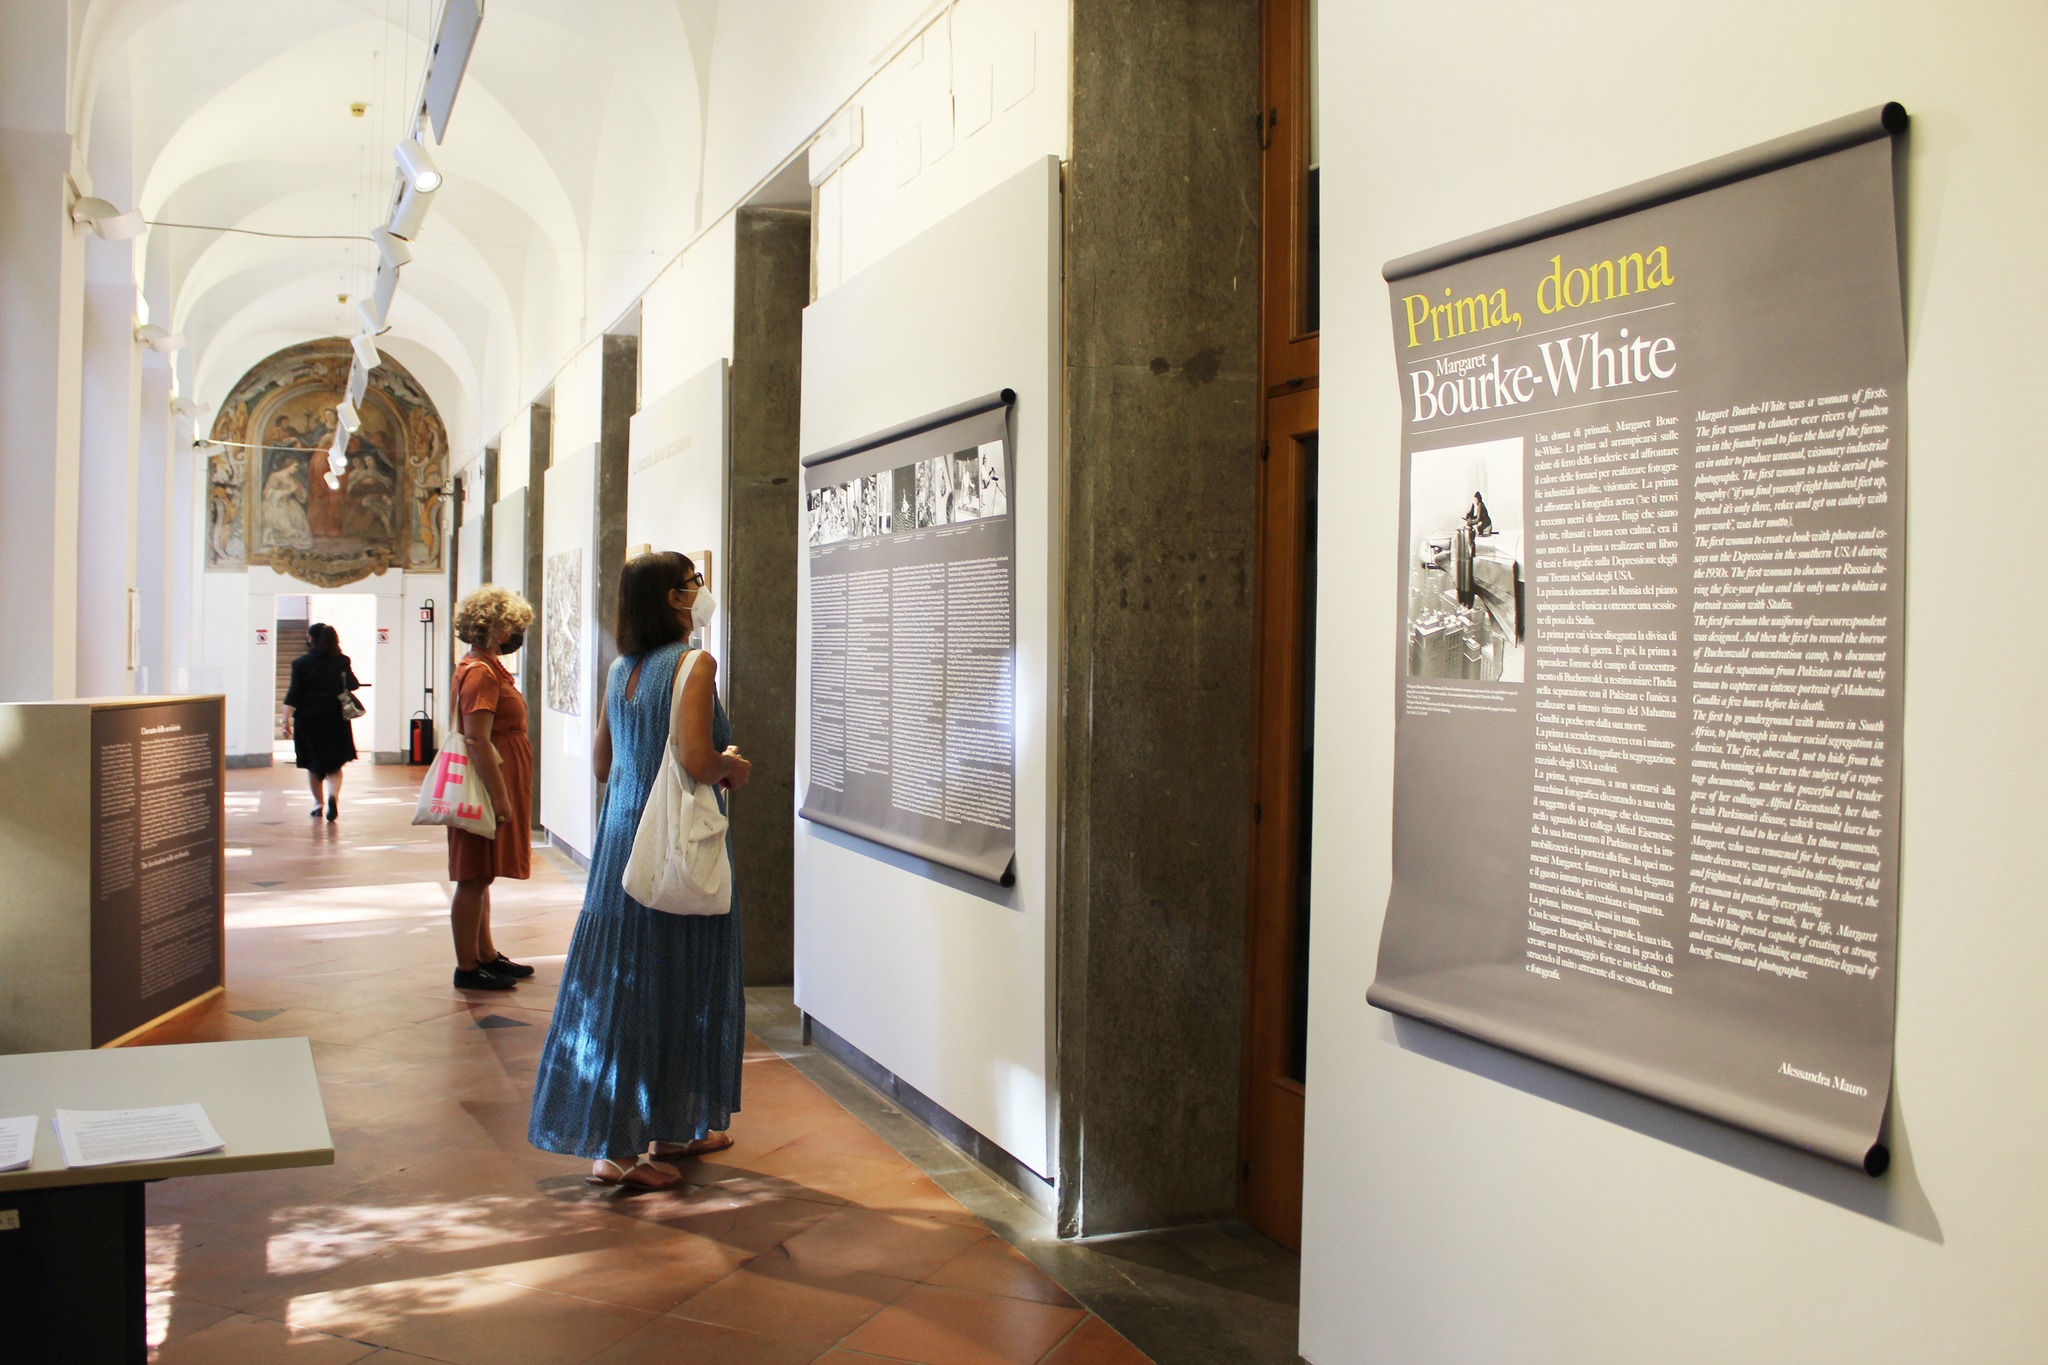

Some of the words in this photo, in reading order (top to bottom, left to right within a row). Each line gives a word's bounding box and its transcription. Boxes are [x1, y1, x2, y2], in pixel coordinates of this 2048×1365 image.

[1402, 287, 1522, 348] Prima,
[1537, 246, 1675, 315] donna
[1409, 328, 1677, 422] Bourke-White
[1436, 353, 1487, 377] Margaret
[1694, 408, 1729, 422] Margaret
[1731, 400, 1786, 417] Bourke-White
[1788, 399, 1805, 409] was
[1807, 398, 1814, 407] a
[1817, 393, 1848, 405] woman
[1851, 388, 1863, 404] of
[1535, 433, 1548, 442] Una
[1550, 431, 1570, 440] donna
[1573, 427, 1580, 437] di
[1584, 423, 1611, 438] primati,
[1615, 419, 1651, 432] Margaret
[1655, 415, 1679, 426] Bour-
[1696, 426, 1710, 437] The
[1709, 424, 1726, 438] first
[1728, 422, 1756, 433] woman
[1757, 420, 1766, 429] to
[1767, 415, 1799, 428] clamber
[1800, 414, 1820, 424] over
[1820, 410, 1845, 422] rivers
[1847, 406, 1859, 422] of
[1858, 404, 1888, 417] molten
[1534, 445, 1563, 456] ke-White.
[1565, 443, 1575, 452] La
[1576, 441, 1596, 453] prima
[1598, 437, 1607, 448] ad
[1659, 429, 1679, 441] sulle
[1742, 469, 1757, 480] The
[1756, 467, 1775, 482] first
[1775, 467, 1805, 477] woman
[1806, 465, 1815, 474] to
[1816, 460, 1840, 473] tackle
[1841, 457, 1868, 471] aerial
[1867, 456, 1888, 472] pho-
[1576, 483, 1601, 494] insolite,
[1602, 480, 1639, 491] visionarie.
[1641, 478, 1653, 488] La
[1654, 476, 1678, 490] prima
[1540, 517, 1565, 526] trecento
[1567, 513, 1584, 524] metri
[1585, 513, 1593, 523] di
[1594, 512, 1620, 522] altezza,
[1621, 509, 1639, 522] fingi
[1640, 508, 1655, 518] che
[1656, 507, 1678, 518] siano
[1693, 503, 1722, 518] pretend
[1733, 501, 1750, 515] only
[1751, 500, 1772, 512] three,
[1773, 498, 1794, 510] relax
[1794, 496, 1812, 509] and
[1811, 497, 1825, 510] get
[1825, 498, 1836, 506] on
[1837, 492, 1866, 508] calmly
[1867, 491, 1887, 504] with
[1535, 531, 1548, 540] solo
[1561, 528, 1585, 539] rilassati
[1592, 527, 1613, 537] lavora
[1657, 525, 1670, 533] era
[1672, 522, 1677, 532] il
[1572, 543, 1581, 552] La
[1583, 542, 1603, 554] prima
[1604, 543, 1609, 551] a
[1610, 540, 1644, 551] realizzare
[1645, 541, 1656, 549] un
[1658, 538, 1677, 548] libro
[1693, 584, 1709, 597] ring
[1709, 583, 1722, 593] the
[1720, 582, 1755, 596] five-year
[1754, 582, 1774, 596] plan
[1774, 581, 1792, 593] and
[1792, 581, 1805, 592] the
[1806, 580, 1824, 595] only
[1824, 583, 1840, 592] one
[1841, 582, 1850, 591] to
[1851, 579, 1878, 591] obtain
[1879, 582, 1886, 590] a
[1537, 658, 1568, 668] riprendere
[1591, 659, 1602, 669] del
[1603, 662, 1627, 672] campo
[1628, 660, 1636, 670] di
[1638, 663, 1677, 671] concentra-
[1692, 646, 1703, 659] of
[1703, 646, 1749, 658] Buchenwald
[1751, 648, 1802, 659] concentration
[1804, 651, 1829, 663] camp,
[1832, 650, 1842, 660] to
[1844, 649, 1886, 661] document
[1535, 699, 1565, 709] realizzare
[1577, 701, 1600, 712] intenso
[1601, 703, 1625, 714] ritratto
[1626, 705, 1638, 715] del
[1640, 705, 1676, 718] Mahatma
[1693, 709, 1707, 720] The
[1705, 710, 1723, 723] first
[1724, 712, 1732, 722] to
[1732, 715, 1742, 725] go
[1744, 713, 1793, 727] underground
[1794, 716, 1814, 727] with
[1815, 717, 1845, 729] miners
[1846, 718, 1856, 730] in
[1857, 719, 1884, 731] South
[1534, 767, 1544, 778] La
[1545, 770, 1567, 781] prima,
[1614, 781, 1627, 789] non
[1629, 783, 1659, 793] sottrarsi
[1661, 784, 1675, 795] alla
[1707, 773, 1755, 791] documenting,
[1758, 779, 1782, 791] under
[1782, 781, 1796, 793] the
[1796, 784, 1835, 798] powerful
[1835, 787, 1854, 799] and
[1855, 789, 1883, 801] tender
[1689, 790, 1707, 801] gaze
[1708, 790, 1718, 803] of
[1717, 790, 1731, 802] her
[1731, 792, 1765, 808] colleague
[1765, 796, 1792, 810] Alfred
[1844, 804, 1860, 816] her
[1689, 896, 1709, 910] With
[1711, 901, 1725, 912] her
[1726, 904, 1753, 920] images,
[1756, 909, 1770, 921] her
[1772, 915, 1797, 928] words,
[1800, 917, 1815, 930] her
[1816, 920, 1832, 935] life,
[1836, 924, 1877, 942] Margaret
[1778, 1062, 1830, 1087] Alessandra
[1832, 1076, 1868, 1097] Mauro
